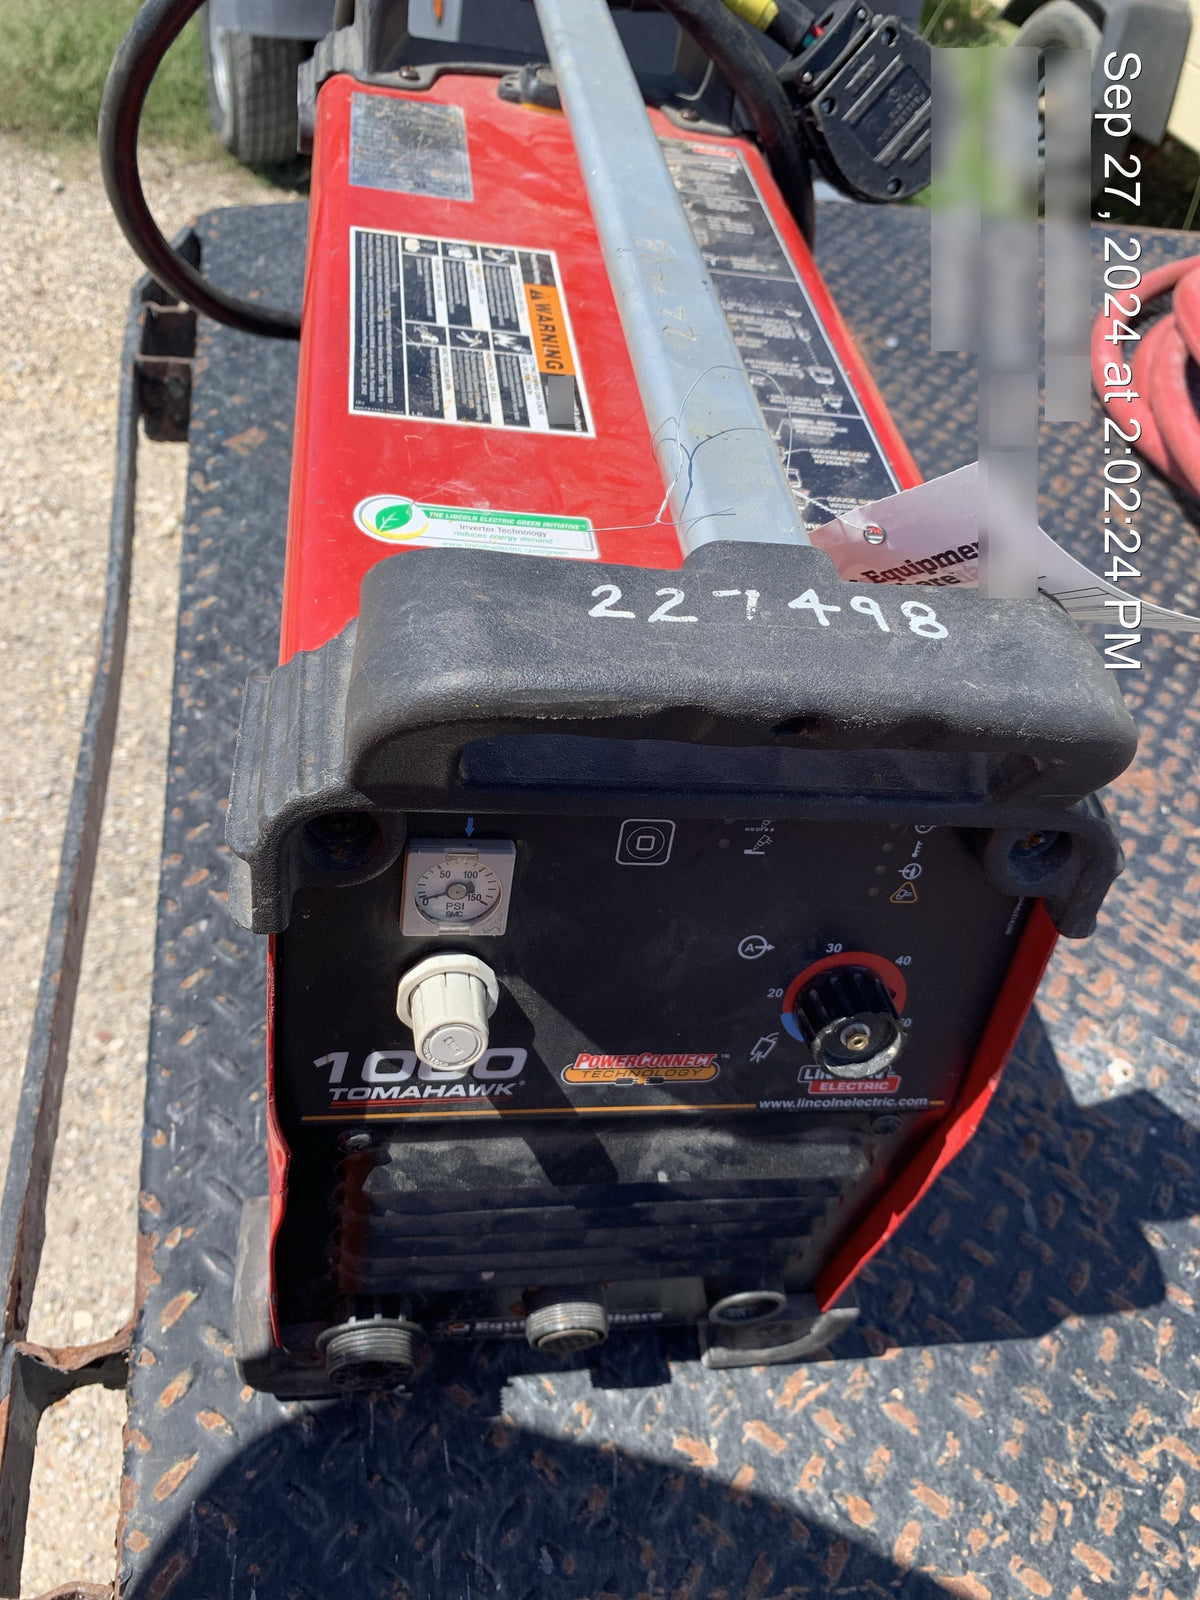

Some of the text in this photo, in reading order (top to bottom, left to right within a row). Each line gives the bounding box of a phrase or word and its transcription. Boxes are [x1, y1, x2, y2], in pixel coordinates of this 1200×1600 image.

[535, 303, 564, 371] WARNING
[428, 511, 580, 531] THE LINCOLN ELECTRIC GREEN INITIATIVE
[453, 530, 553, 544] reduces energy demand
[459, 523, 547, 538] Inverter Technology
[861, 541, 979, 585] Equipme
[439, 870, 478, 878] 50 100
[467, 893, 482, 901] 150
[445, 902, 465, 910] PSI
[825, 943, 842, 953] 30
[895, 955, 912, 965] 40
[767, 988, 784, 998] 20
[581, 1068, 702, 1079] TECHNOLOGY
[329, 1082, 518, 1101] TOMAHAWK
[819, 1081, 890, 1092] ELECTRIC
[759, 1096, 929, 1109] www.lincolnelectric.com
